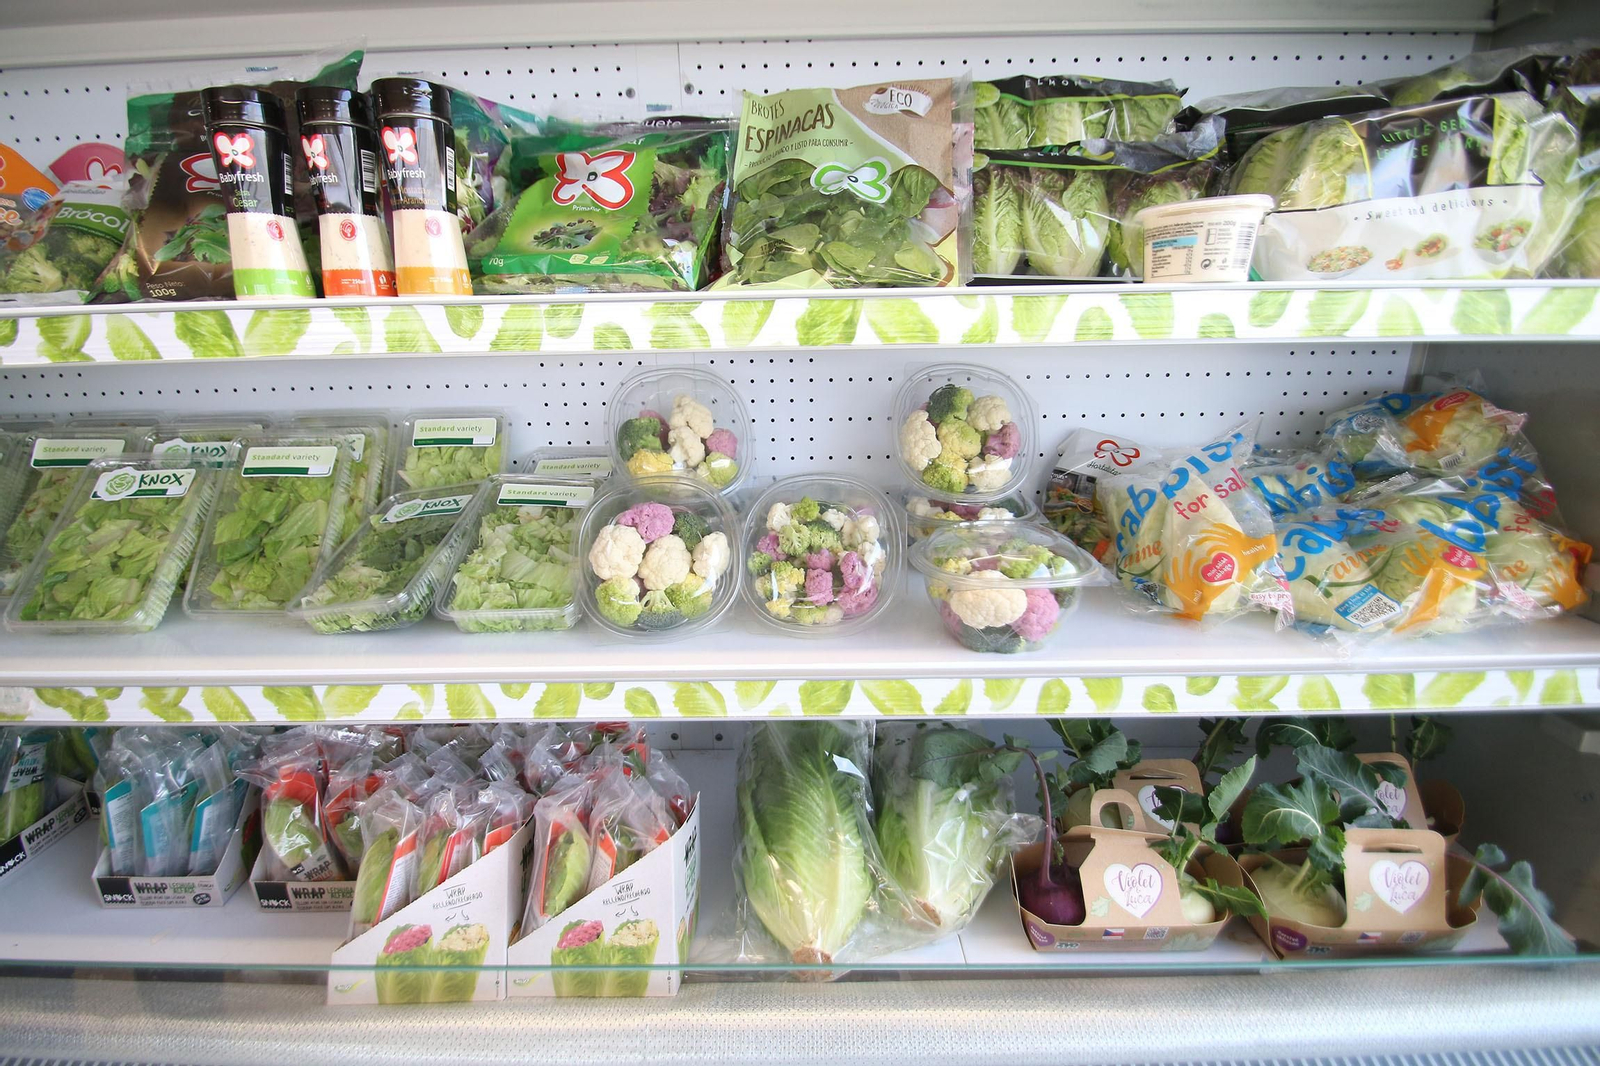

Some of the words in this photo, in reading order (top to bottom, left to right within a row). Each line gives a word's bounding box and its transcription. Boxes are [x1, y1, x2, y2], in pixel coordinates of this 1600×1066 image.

[890, 89, 912, 107] ECO
[751, 99, 785, 123] BROTES
[745, 103, 835, 153] ESPINACAS
[1381, 124, 1431, 143] LITTLE
[794, 139, 808, 151] LISTO
[808, 139, 822, 148] PARA
[822, 138, 849, 148] CONSUMIR
[219, 171, 265, 185] Babyfresh
[308, 172, 339, 186] abyfresh
[1408, 205, 1425, 215] and
[150, 288, 177, 298] 100g
[420, 425, 456, 433] Standard
[456, 425, 483, 433] variety
[42, 445, 80, 454] Standard
[81, 446, 108, 454] variety
[252, 453, 291, 461] Standard
[292, 453, 321, 462] variety
[576, 462, 601, 470] variety
[138, 472, 185, 488] KNOX
[507, 488, 548, 496] Standard
[548, 490, 579, 498] variety
[421, 497, 465, 511] KNOX
[1172, 492, 1209, 521] for
[1241, 543, 1268, 556] healthy
[1206, 567, 1218, 578] mini
[1215, 556, 1229, 570] salad
[1213, 563, 1234, 581] cabbage
[1251, 594, 1266, 602] easy
[1375, 784, 1399, 800] iolet
[25, 817, 56, 846] WRAP
[304, 859, 331, 880] WRAP
[1111, 869, 1156, 892] Violet
[1378, 866, 1421, 888] Violet
[134, 882, 168, 894] WRAP
[291, 886, 326, 899] WRAP
[446, 886, 466, 899] WRAP
[614, 882, 634, 895] WRAP
[1389, 884, 1417, 905] Luca
[1126, 886, 1154, 909] Luca
